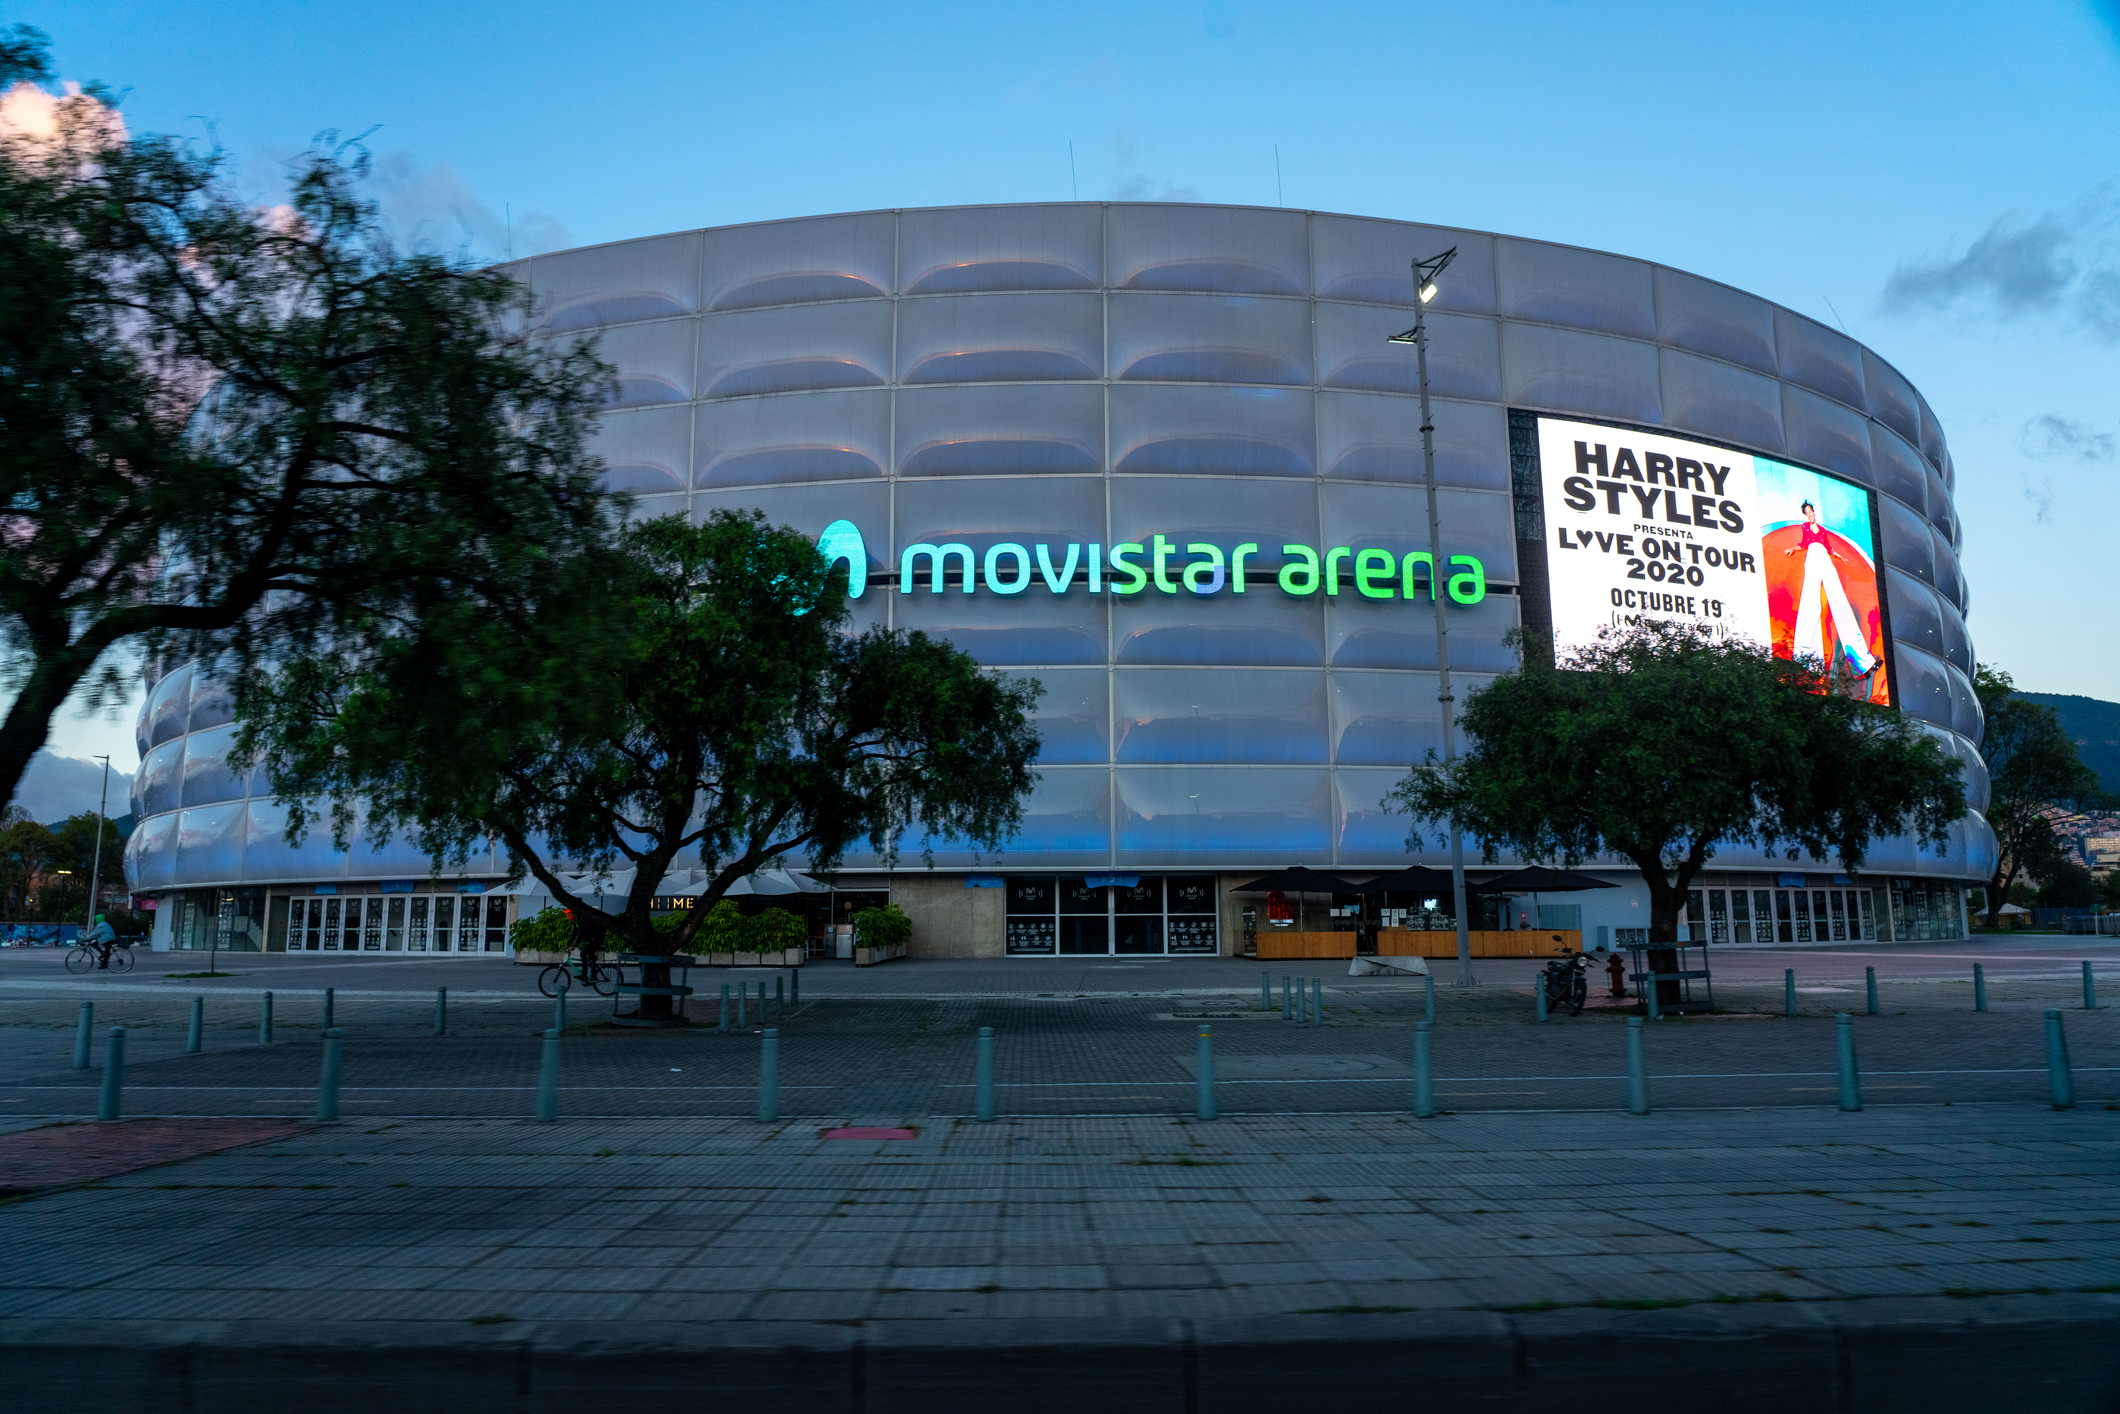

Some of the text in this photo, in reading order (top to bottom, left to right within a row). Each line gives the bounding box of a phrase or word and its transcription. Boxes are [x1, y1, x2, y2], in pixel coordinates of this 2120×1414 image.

[1574, 441, 1730, 496] HARRY
[1563, 476, 1744, 533] STYLES
[1633, 524, 1694, 540] PRESENTA
[900, 534, 1487, 606] movistar arena
[1642, 538, 1681, 563] ON
[1685, 543, 1756, 573] TOUR
[1627, 558, 1705, 587] 2020
[1610, 587, 1722, 618] OCTUBRE 19
[1687, 623, 1713, 633] arna
[1109, 873, 1116, 883] 5
